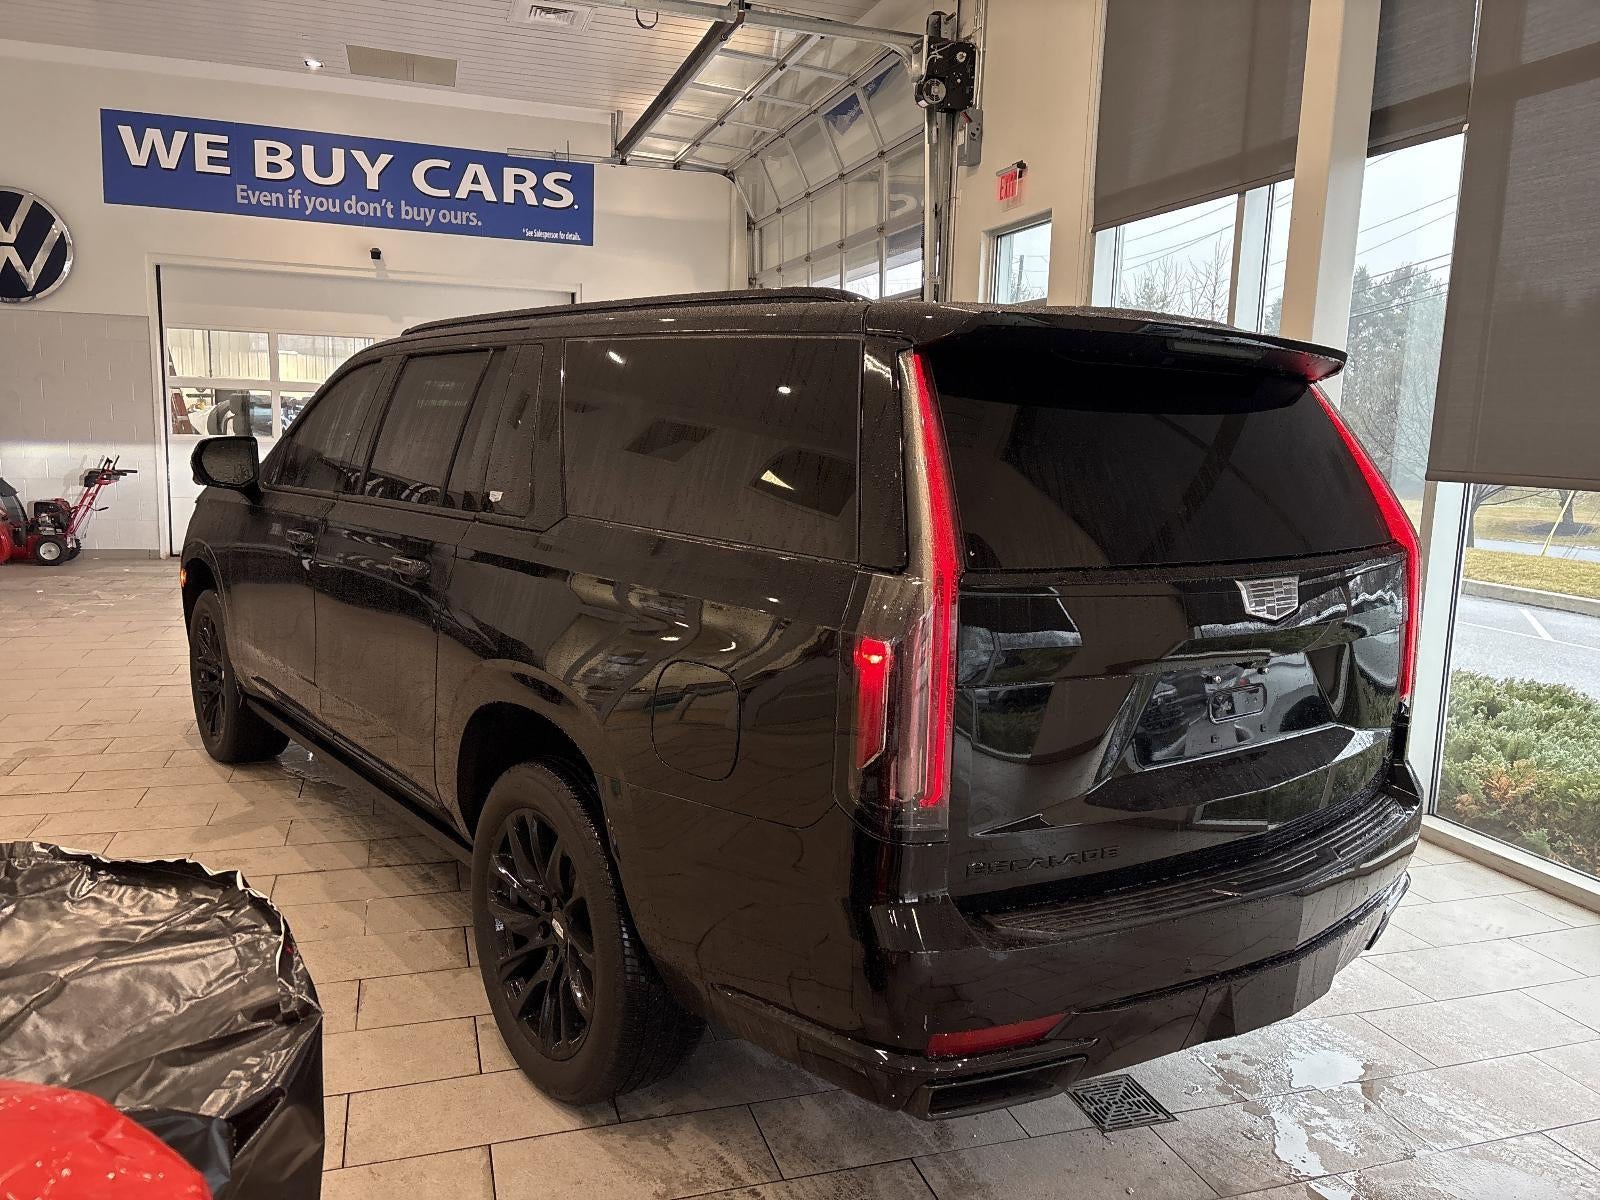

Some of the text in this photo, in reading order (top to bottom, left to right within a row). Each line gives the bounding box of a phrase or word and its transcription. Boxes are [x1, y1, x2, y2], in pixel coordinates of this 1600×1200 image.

[117, 124, 580, 209] WE BUY CARS.
[235, 184, 483, 227] Even if you don't buy ours.
[533, 228, 559, 240] Salesperson
